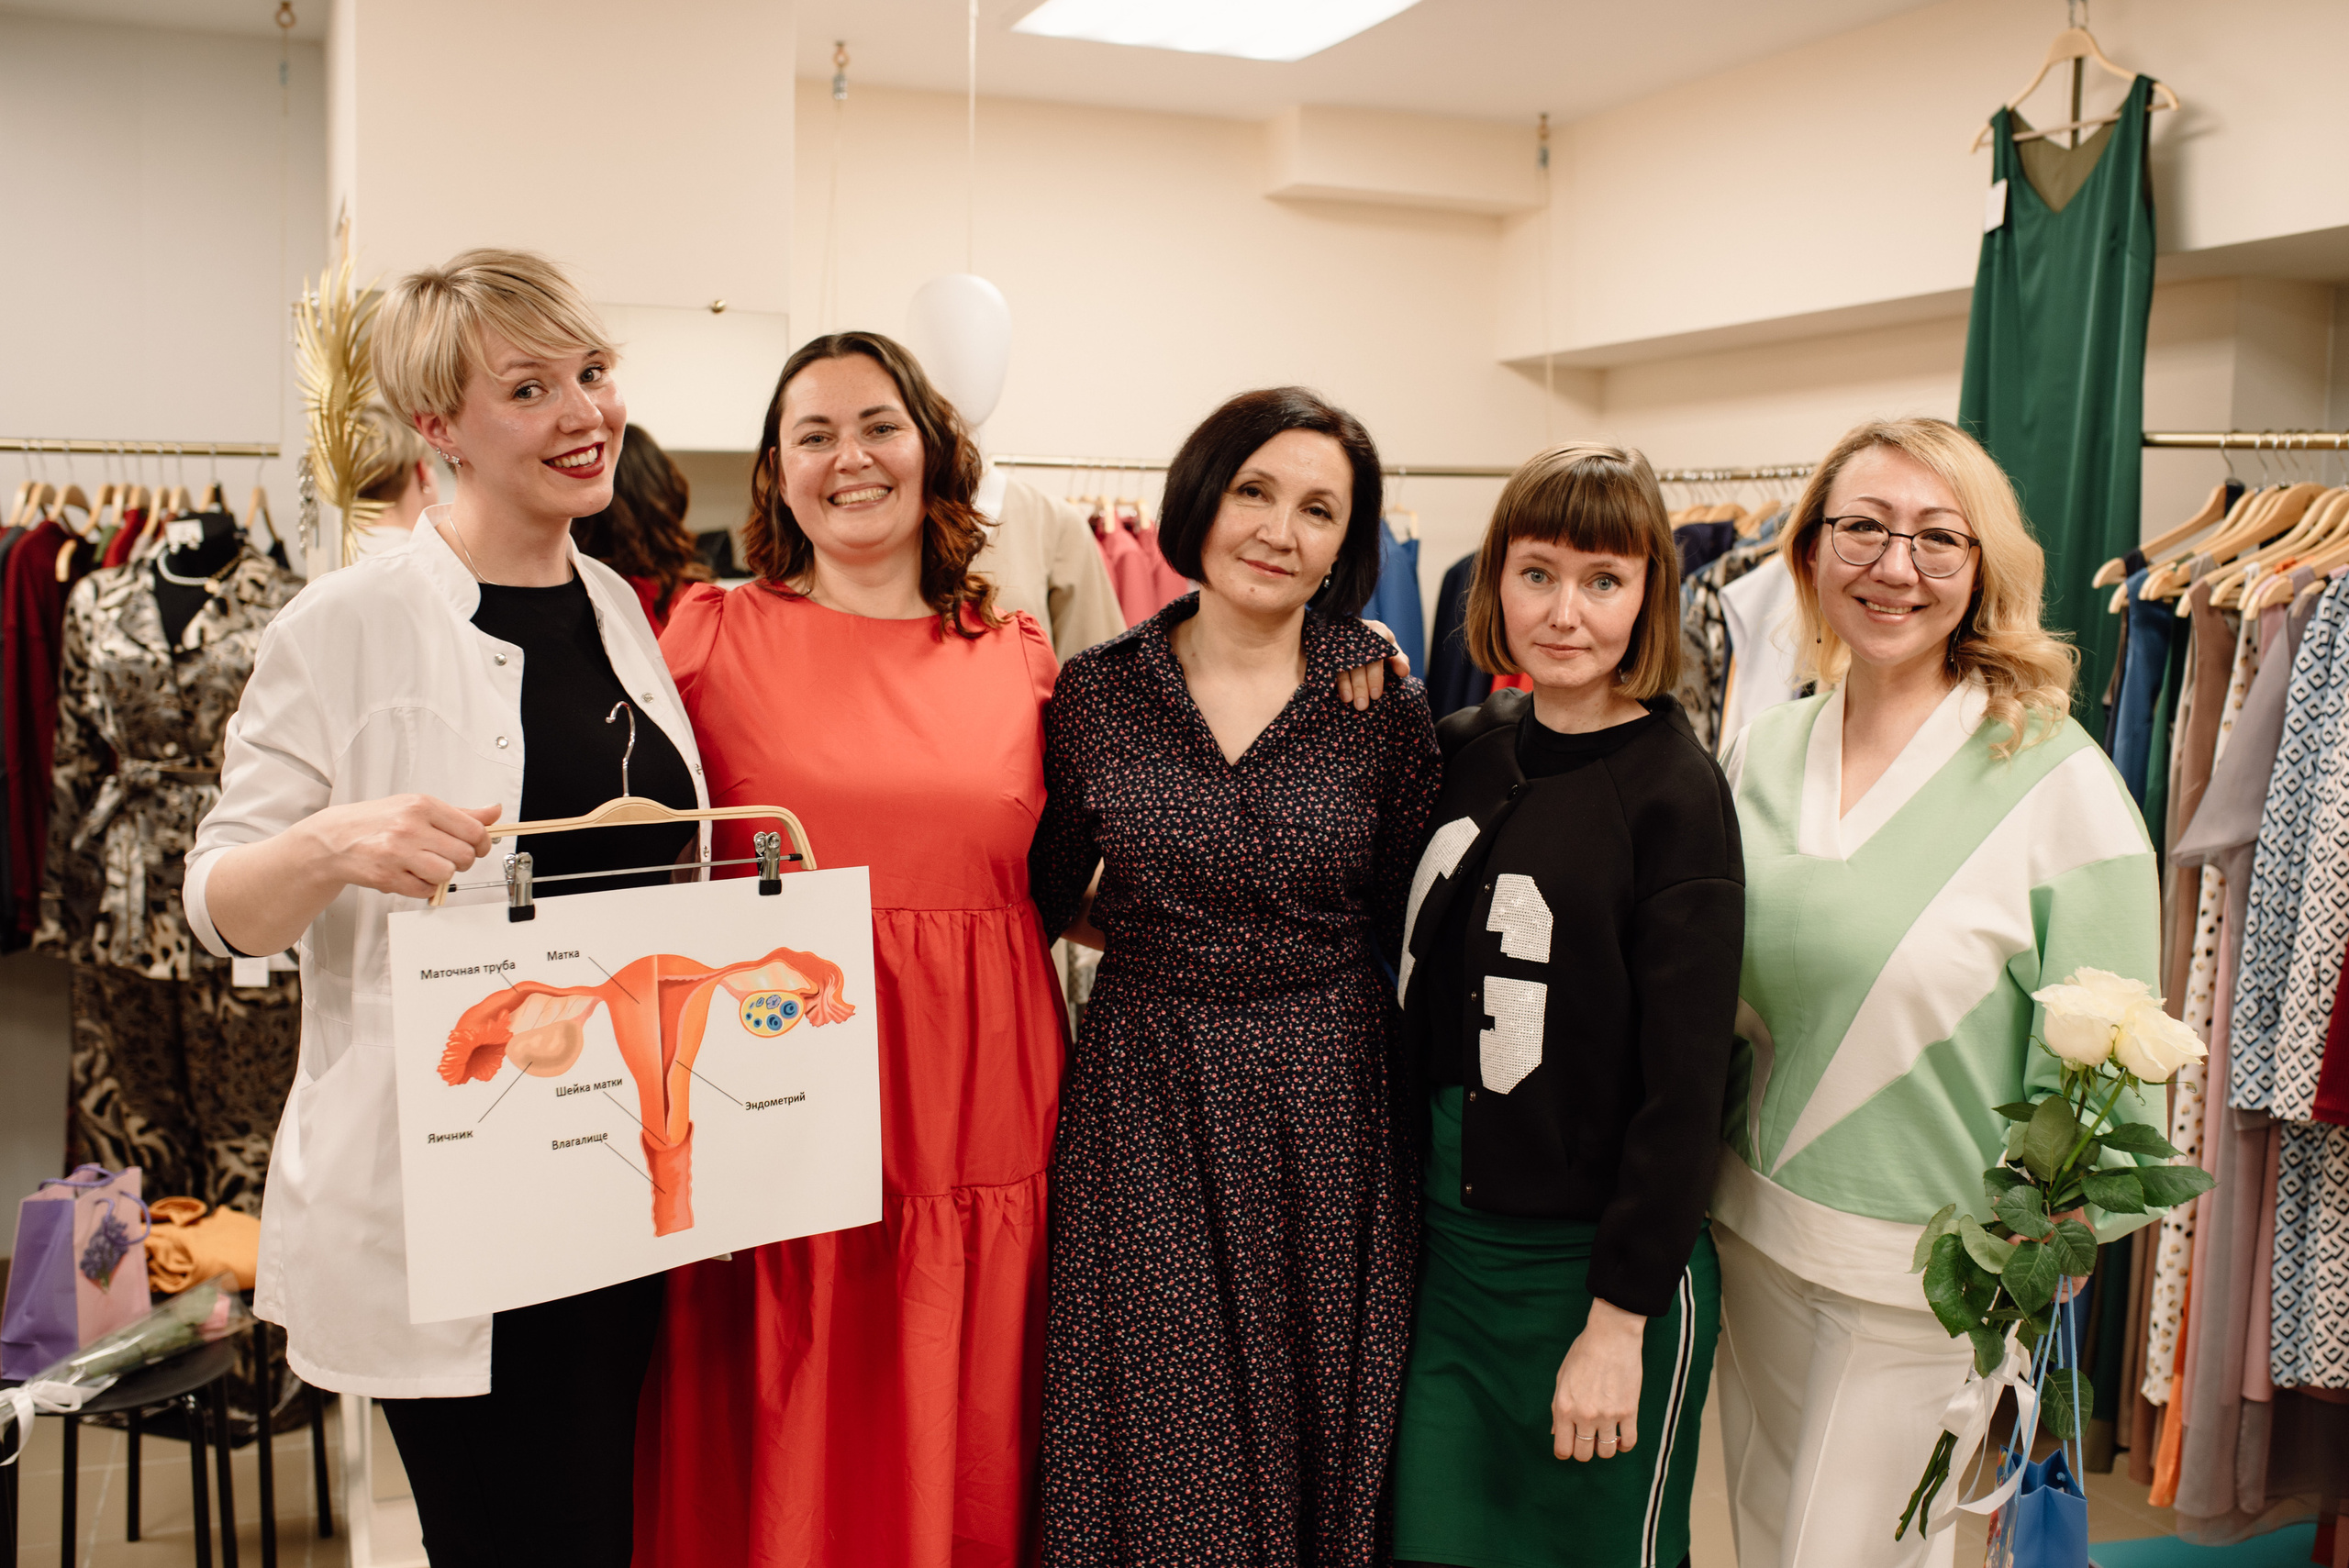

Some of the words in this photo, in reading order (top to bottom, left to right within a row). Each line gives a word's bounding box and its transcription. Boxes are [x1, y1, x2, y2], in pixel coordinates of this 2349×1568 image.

[547, 950, 580, 962] Матка
[420, 965, 480, 980] Маточная
[483, 960, 516, 974] труба
[555, 1084, 591, 1097] Шейка
[593, 1078, 623, 1091] матки
[745, 1091, 806, 1111] Эндометрий
[428, 1129, 473, 1144] Яичник
[551, 1132, 608, 1150] Влагалище
